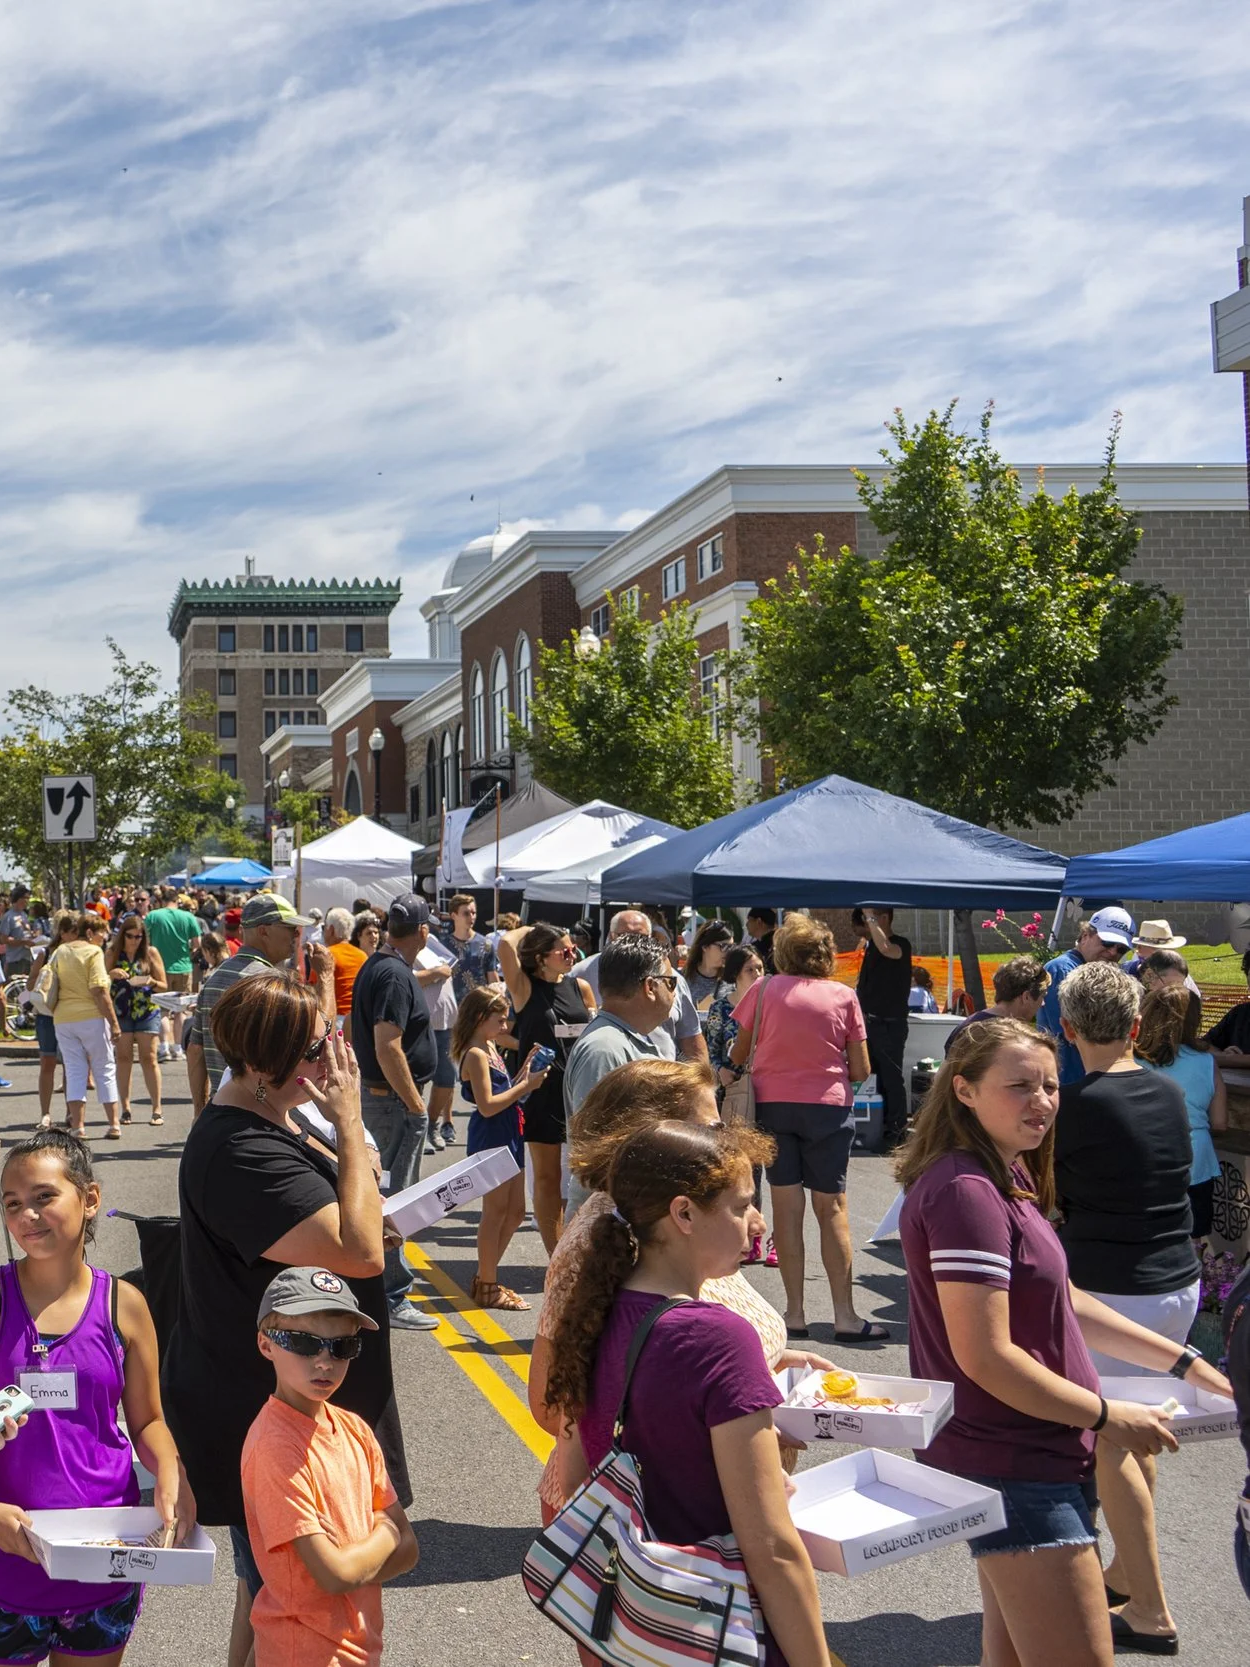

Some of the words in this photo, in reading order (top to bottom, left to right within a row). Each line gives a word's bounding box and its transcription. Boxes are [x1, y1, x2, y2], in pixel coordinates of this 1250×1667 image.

[30, 1384, 69, 1399] Emma
[1198, 1422, 1227, 1434] FOOD
[863, 1531, 926, 1560] LOCKPORT
[927, 1520, 959, 1541] FOOD
[961, 1511, 988, 1530] FEST
